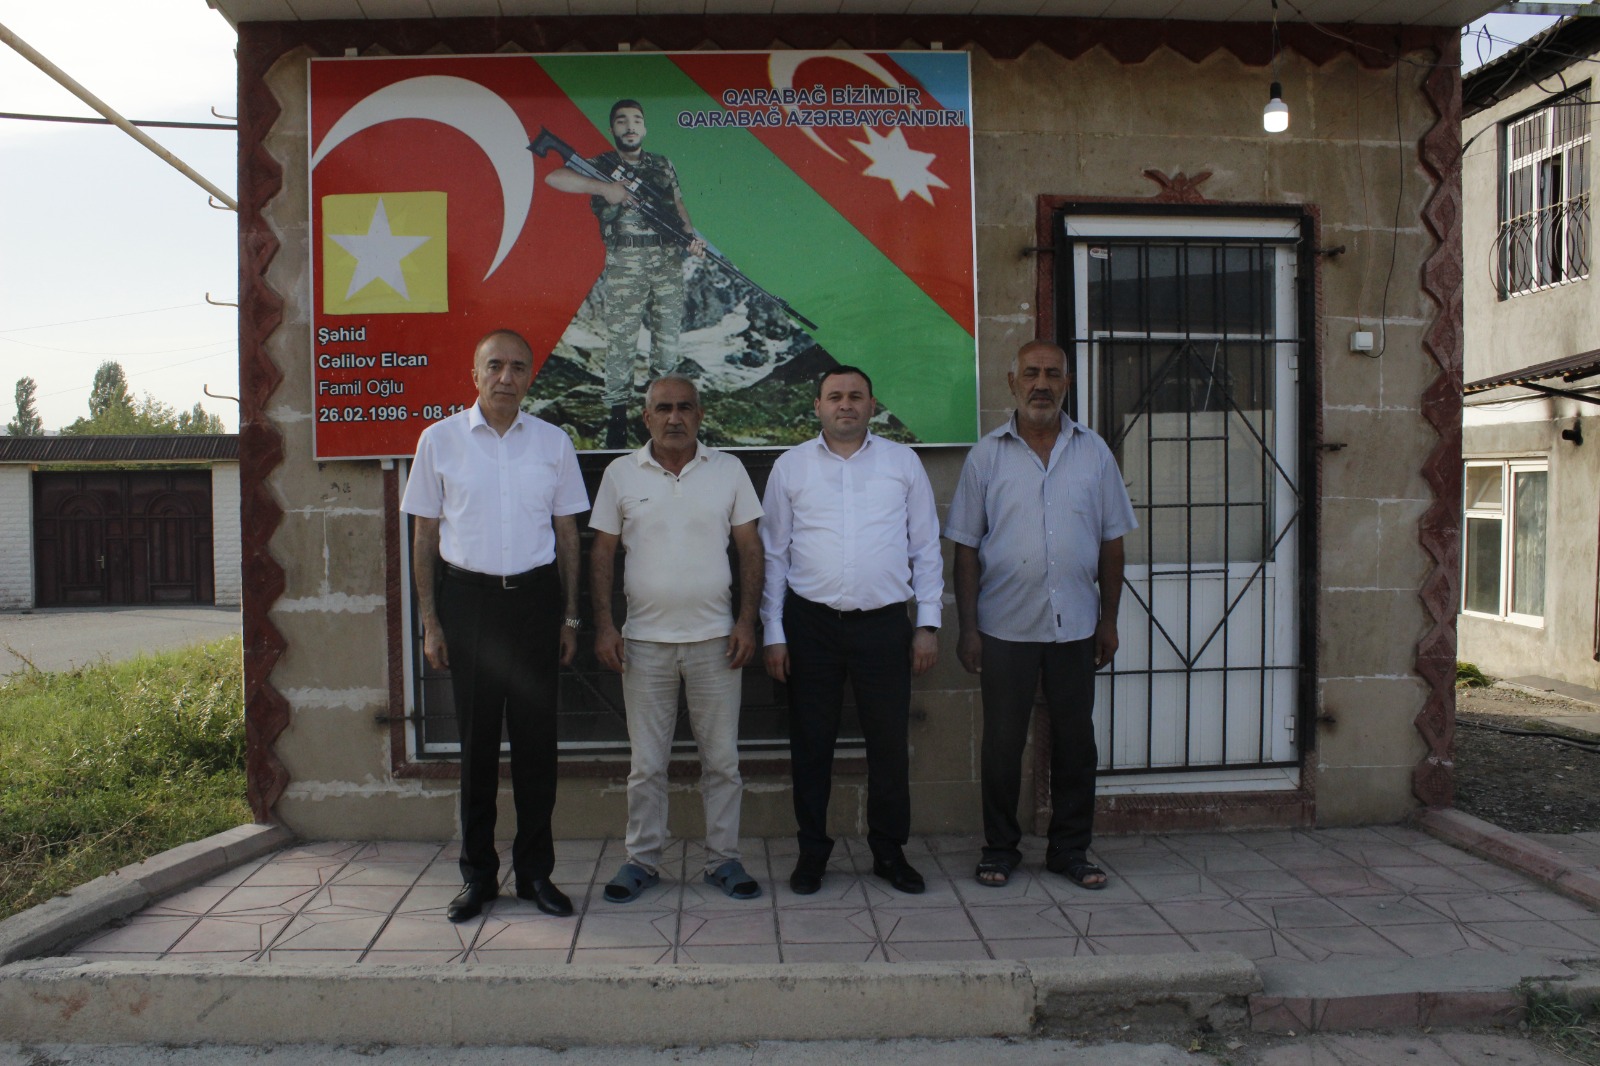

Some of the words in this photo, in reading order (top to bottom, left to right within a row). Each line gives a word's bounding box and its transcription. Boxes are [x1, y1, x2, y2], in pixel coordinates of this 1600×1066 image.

[722, 85, 826, 105] QARABAĞ
[831, 84, 921, 105] BİZİMDİR
[677, 107, 782, 128] QARABAĞ
[784, 109, 965, 127] AZƏRBAYCANDIR!
[318, 327, 366, 345] Şəhid
[318, 353, 376, 368] Cəlilov
[381, 353, 428, 367] Elcan
[319, 381, 361, 395] Famil
[366, 379, 404, 397] Oğlu
[319, 406, 408, 422] 26.02.1996
